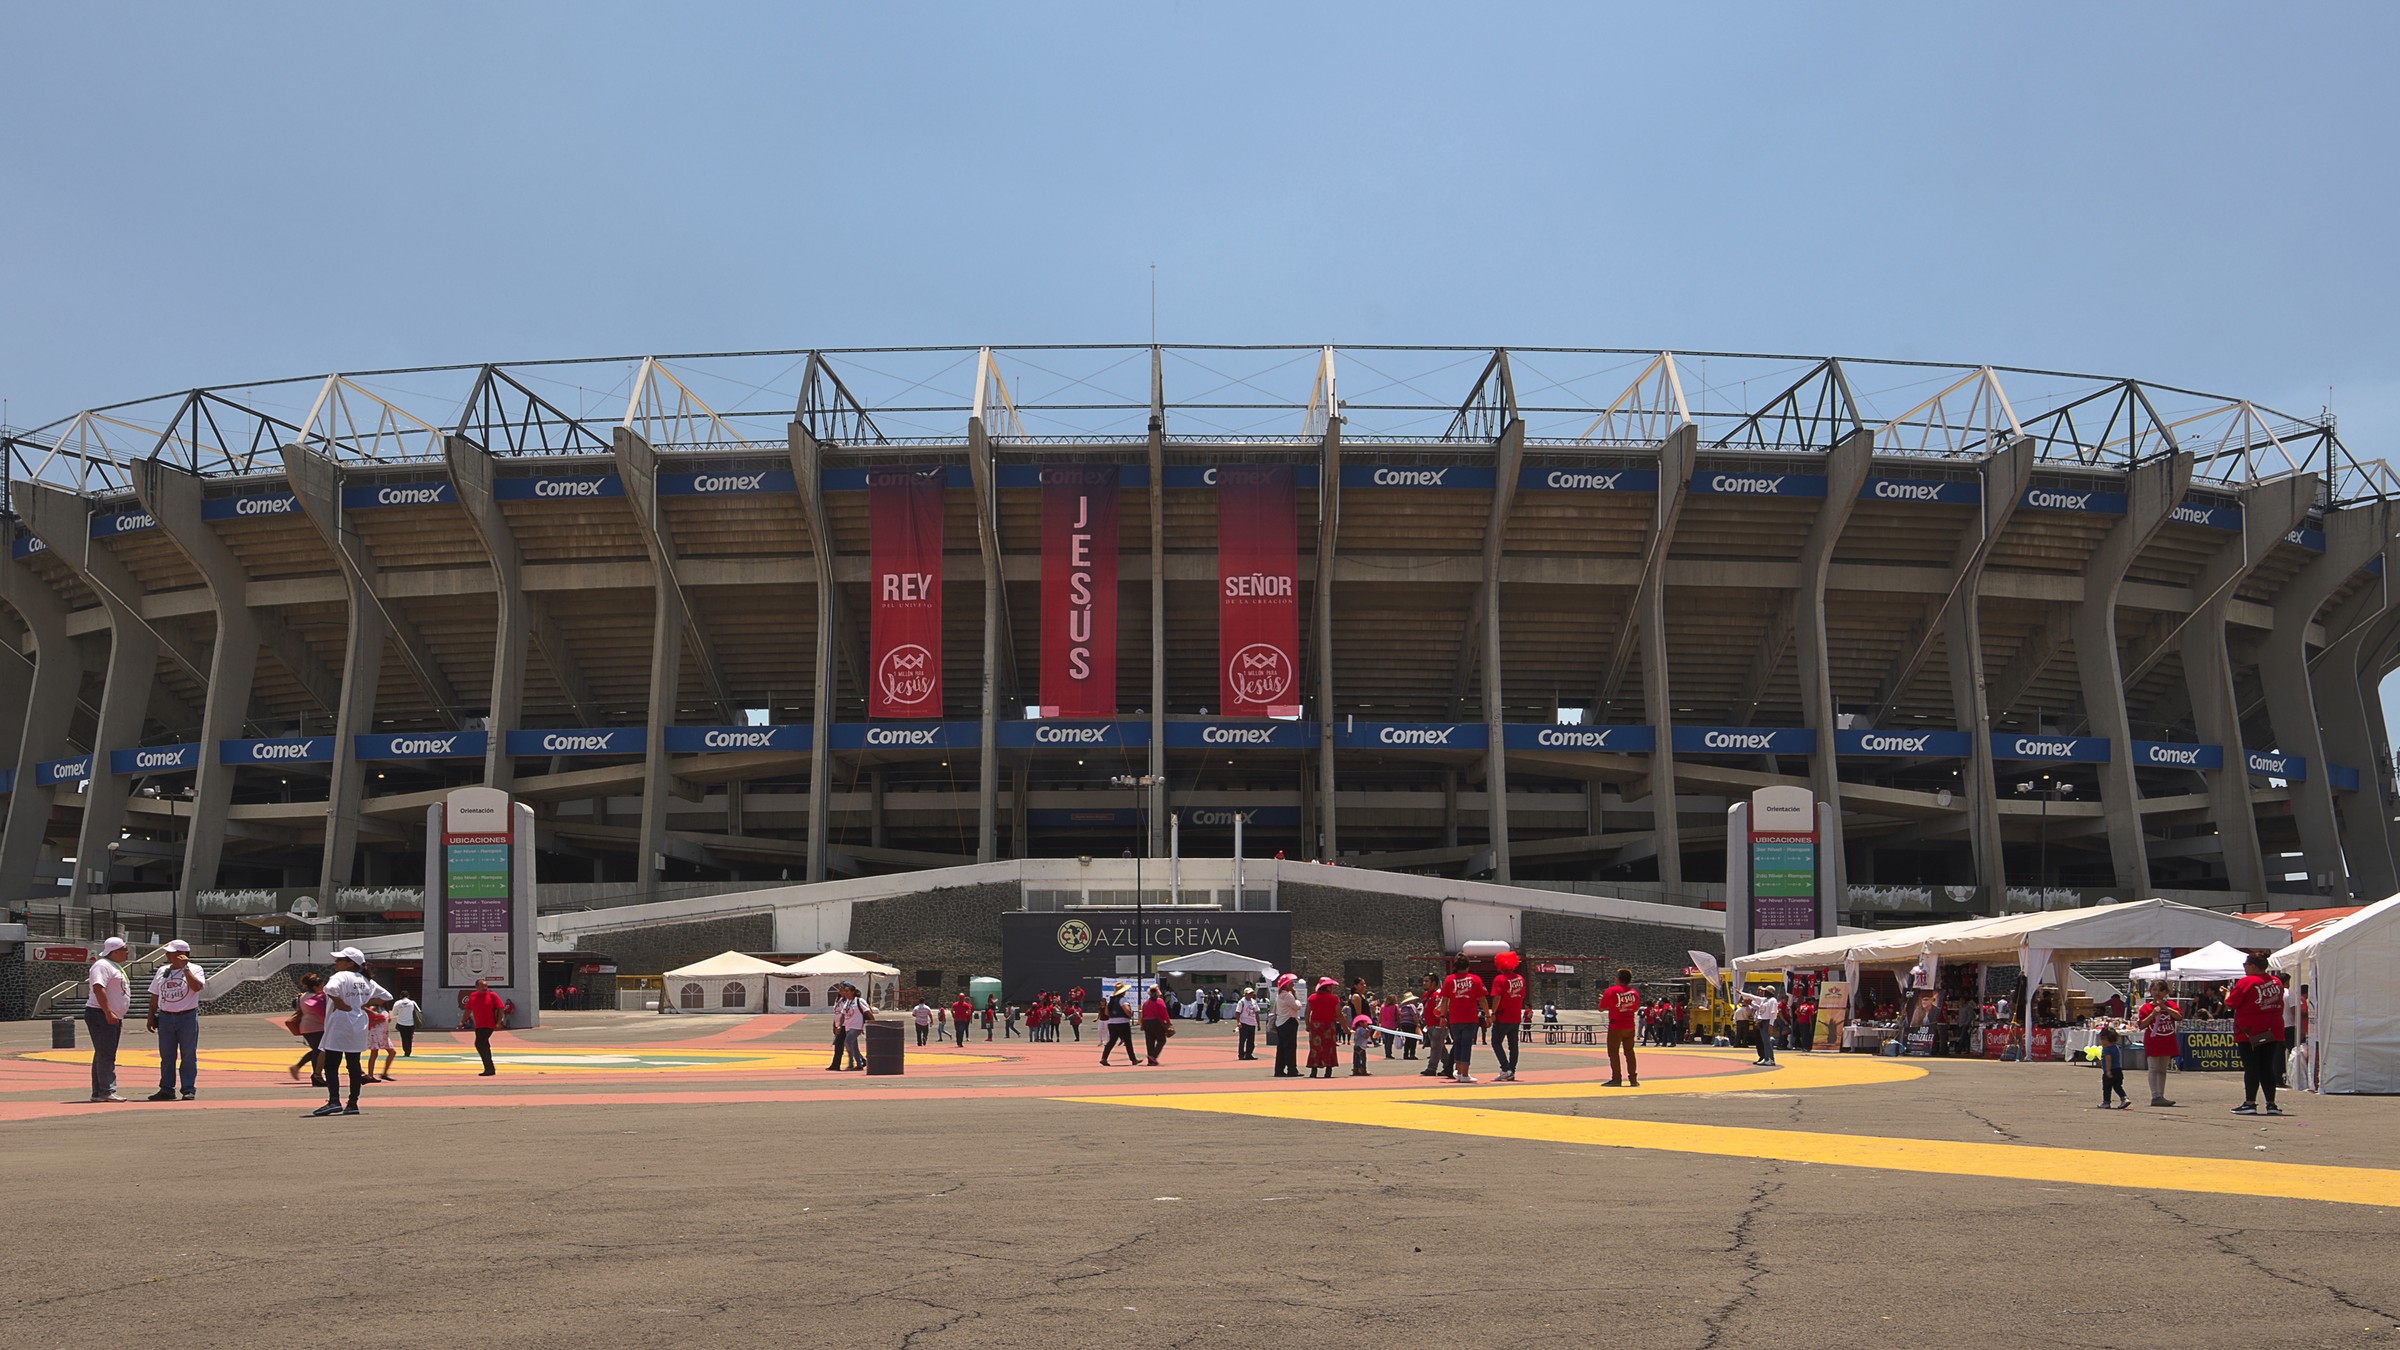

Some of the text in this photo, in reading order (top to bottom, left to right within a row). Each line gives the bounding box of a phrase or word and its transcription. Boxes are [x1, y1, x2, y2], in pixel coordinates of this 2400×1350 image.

[693, 471, 766, 492] Comex
[1373, 468, 1448, 486] Comex
[1547, 471, 1622, 490] Comex
[1712, 475, 1785, 494] Comex
[379, 485, 445, 504] Comex
[535, 477, 605, 497] Comex
[1875, 481, 1945, 500] Comex
[237, 496, 295, 515] Comex
[2028, 490, 2092, 510] Comex
[116, 514, 156, 531] Come
[2169, 507, 2214, 525] omex
[883, 573, 933, 601] REY
[1069, 496, 1092, 680] JESÚS
[1225, 572, 1292, 597] SEÑOR
[883, 673, 930, 704] Jesús
[1233, 672, 1285, 704] Jesús
[543, 732, 614, 751] Comex
[704, 728, 777, 747] Comex
[866, 726, 940, 745] Comex
[1035, 724, 1111, 743] Comex
[1202, 726, 1277, 744] Comex
[1380, 726, 1455, 745] Comex
[1538, 727, 1612, 746] Comex
[1704, 731, 1777, 749] Comex
[1861, 734, 1931, 752] Comex
[252, 740, 313, 759] Comex
[390, 735, 457, 754] Comex
[2015, 738, 2077, 757] Comex
[136, 748, 186, 768] Comex
[2149, 745, 2201, 764] Comex
[2249, 753, 2287, 773] Comex
[54, 759, 87, 778] Comex
[1119, 917, 1211, 926] MEMBRESÍA
[1094, 927, 1240, 946] AZULCREMA
[2255, 984, 2281, 1004] Jesús
[2188, 1034, 2238, 1048] GRABAD
[2192, 1049, 2223, 1059] PLUMAS
[2224, 1050, 2230, 1058] Y
[2201, 1060, 2229, 1068] CON
